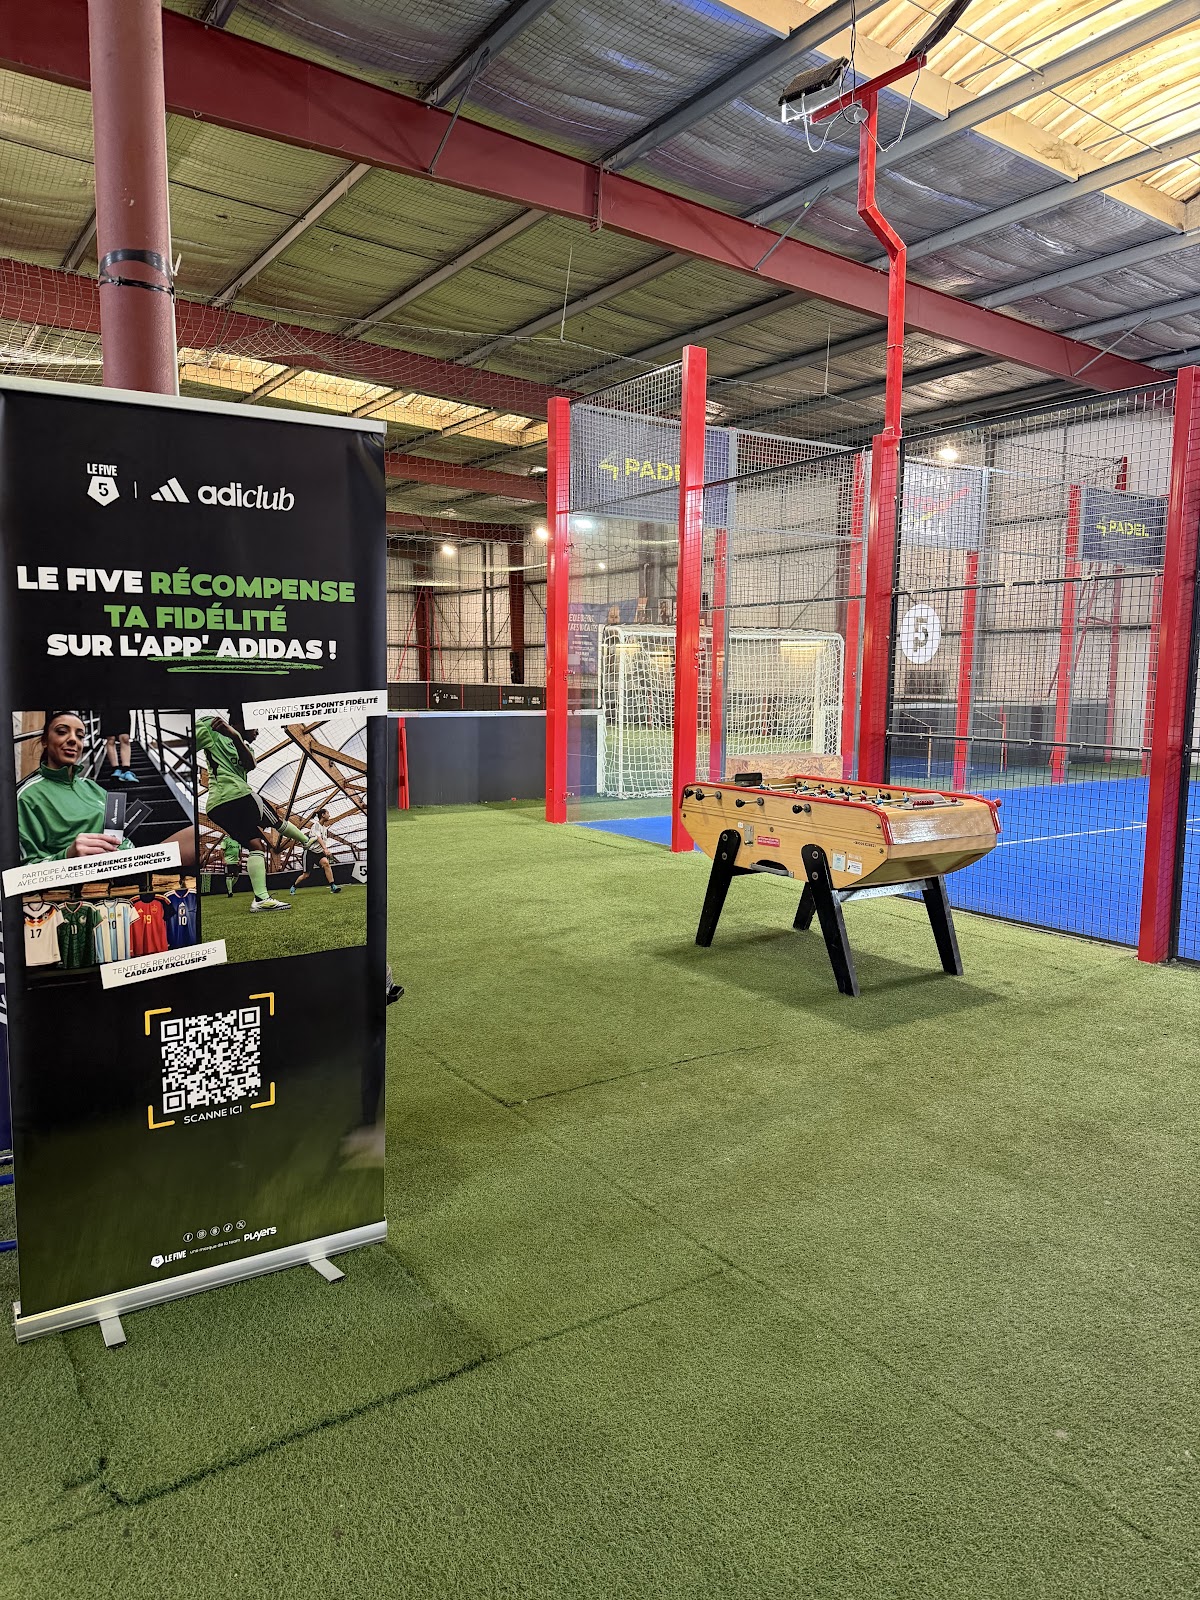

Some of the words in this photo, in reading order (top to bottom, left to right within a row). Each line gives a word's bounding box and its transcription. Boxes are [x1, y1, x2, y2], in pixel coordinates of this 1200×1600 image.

[87, 463, 98, 474] LE
[99, 464, 118, 476] FIVE
[625, 457, 680, 481] PAD
[98, 483, 109, 496] 5
[198, 482, 295, 511] adiclub
[1110, 520, 1149, 537] PADEL
[17, 566, 59, 590] LE
[67, 568, 144, 593] FIVE
[150, 567, 356, 603] RÉCOMPENSE
[104, 605, 149, 628] TA
[157, 602, 287, 632] FIDÉLITÉ
[47, 634, 113, 656] SUR
[120, 632, 209, 658] L'APP'
[216, 638, 323, 660] ADIDAS
[252, 704, 299, 716] CONVERTIS
[316, 700, 344, 709] POINTS
[345, 696, 378, 705] FIDÉLITÉ
[280, 710, 310, 720] HEURES
[323, 707, 338, 715] JEU
[350, 704, 367, 712] FIVE
[17, 878, 38, 887] AVEC
[39, 875, 54, 884] DES
[55, 871, 84, 881] PLACES
[86, 868, 95, 876] DE
[97, 863, 127, 874] MATCHS
[134, 856, 171, 867] CONCERTS
[22, 868, 60, 879] PARTICIPE
[61, 865, 67, 873] À
[68, 864, 83, 872] DES
[84, 855, 133, 869] EXPÉRIENCES
[134, 850, 165, 861] UNIQUES
[30, 928, 42, 939] 17
[113, 963, 139, 975] TENTE
[140, 960, 151, 968] DE
[153, 951, 200, 966] REMPORTER
[201, 947, 217, 955] DES
[125, 965, 163, 978] CADEAUX
[165, 955, 207, 969] EXCLUSIFS
[183, 1108, 227, 1124] SCANNE
[229, 1104, 243, 1115] ICI
[165, 1254, 173, 1263] LE
[173, 1249, 187, 1261] FIVE
